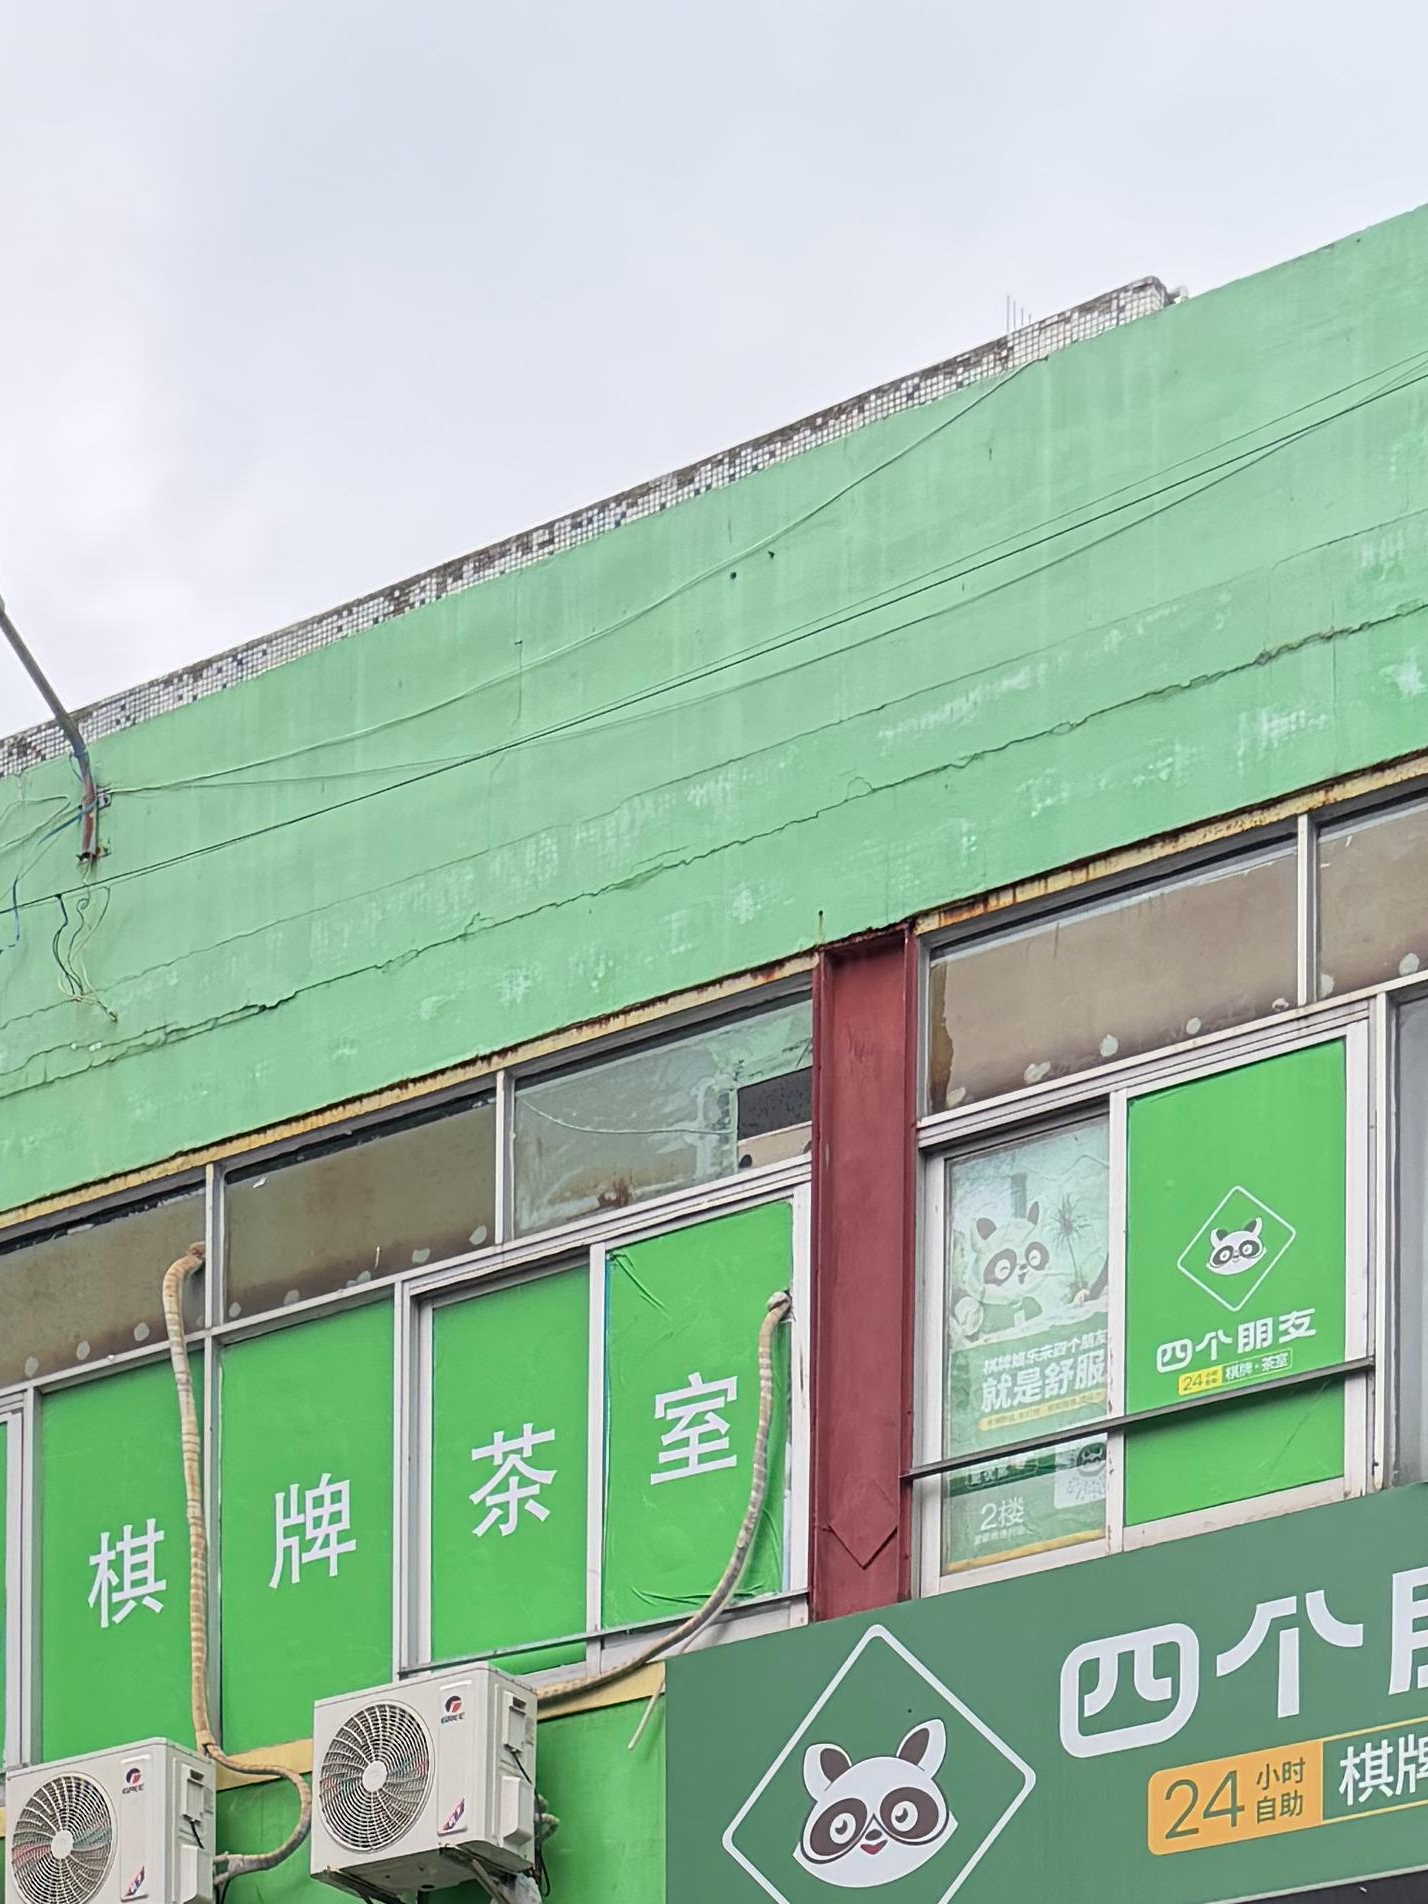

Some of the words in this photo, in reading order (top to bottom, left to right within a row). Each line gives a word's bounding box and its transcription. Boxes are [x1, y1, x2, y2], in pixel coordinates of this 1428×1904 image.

[1156, 1308, 1316, 1374] 四个朋友
[980, 1349, 1106, 1412] 就是舒服
[1182, 1373, 1203, 1392] 24
[980, 1495, 1025, 1531] 2楼
[1255, 1758, 1307, 1792] 小时
[1163, 1769, 1246, 1840] 24
[1255, 1792, 1305, 1825] 自助
